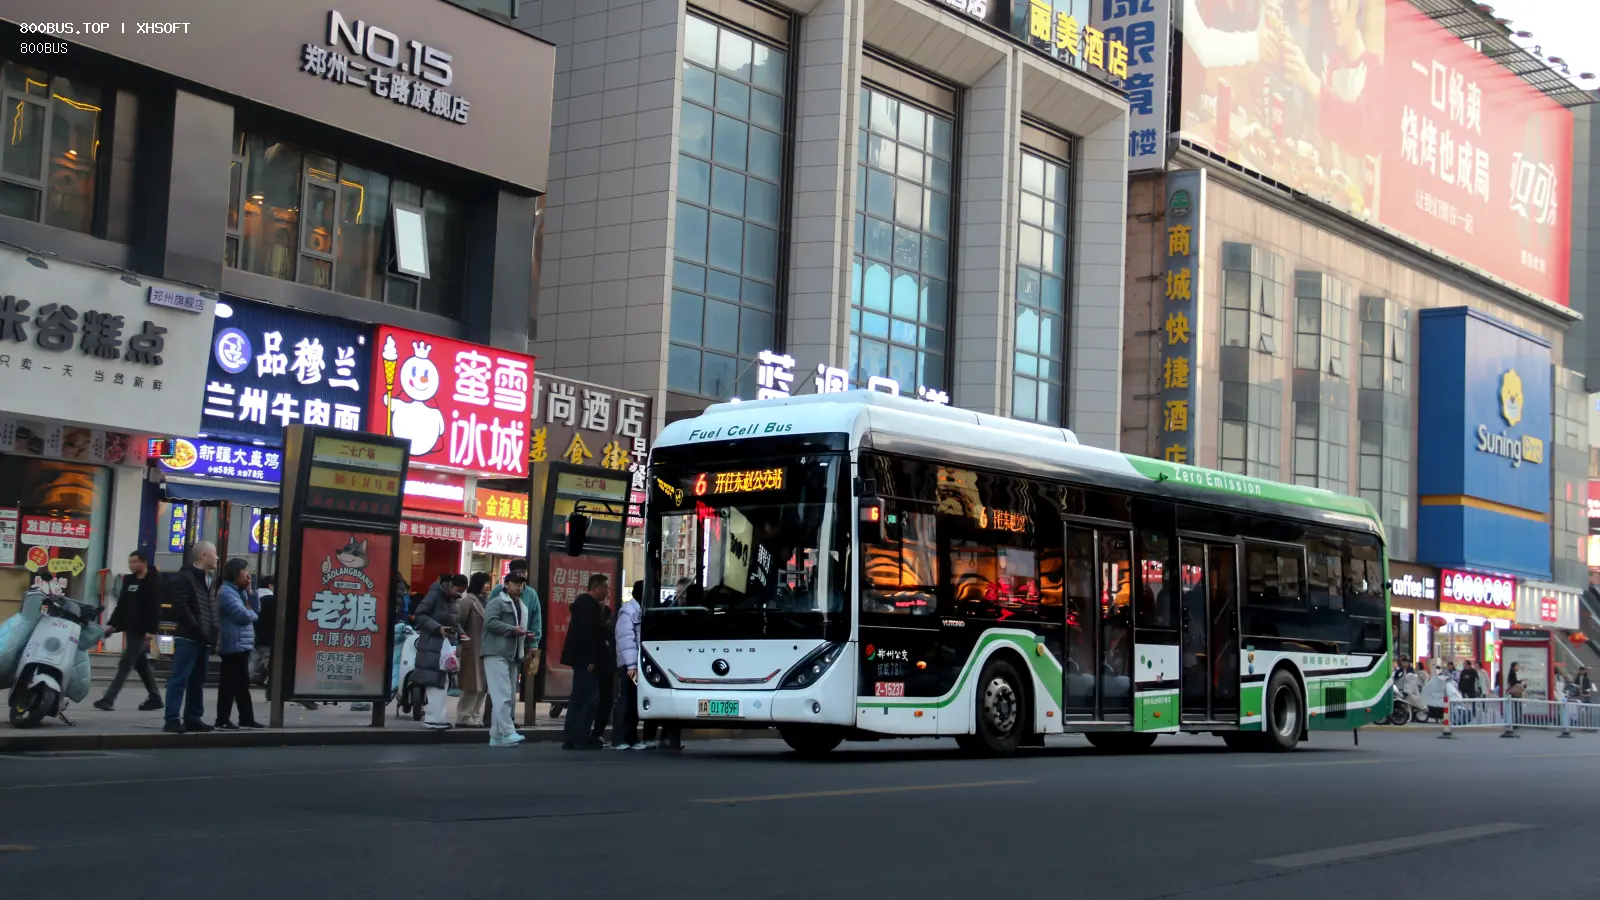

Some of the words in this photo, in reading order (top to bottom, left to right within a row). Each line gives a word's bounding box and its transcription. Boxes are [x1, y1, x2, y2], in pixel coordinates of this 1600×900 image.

[327, 9, 453, 87] NO.15
[1029, 0, 1128, 79] 丽美酒店
[303, 43, 470, 124] 郑州二七路旗舰店
[1412, 59, 1482, 136] 一口畅爽
[1401, 104, 1490, 203] 烧烤也成局
[153, 289, 205, 311] 郑州旗舰店
[0, 295, 168, 366] 米谷糕点
[1164, 224, 1192, 463] 商城快捷酒店
[0, 354, 74, 378] 只卖一天
[93, 369, 163, 392] 当然新鲜
[256, 330, 360, 391] 品穆兰
[452, 350, 528, 412] 蜜雪
[204, 381, 361, 431] 兰州牛肉面
[450, 410, 524, 473] 冰城
[689, 427, 722, 441] Fuel
[727, 423, 760, 437] Cell
[764, 421, 793, 433] Bus
[199, 444, 280, 470] 新疆大盘鸡
[340, 445, 376, 459] 二七广场
[1478, 424, 1522, 468] Suning
[1524, 438, 1543, 462] Pro
[695, 473, 708, 496] 6
[1174, 467, 1201, 484] Zero
[1206, 473, 1261, 494] Emission
[871, 507, 879, 520] 6
[980, 507, 988, 528] 6
[26, 519, 87, 536] 发财接头点
[411, 524, 465, 539] 蜜雪冰城甜蜜蜜
[323, 567, 373, 590] LAOLANGBRAND
[1392, 574, 1422, 598] coffee
[306, 590, 379, 633] 老狼
[312, 631, 372, 648] 中原炒鸡
[877, 648, 909, 662] 郑州公交
[876, 682, 904, 696] 2-15237
